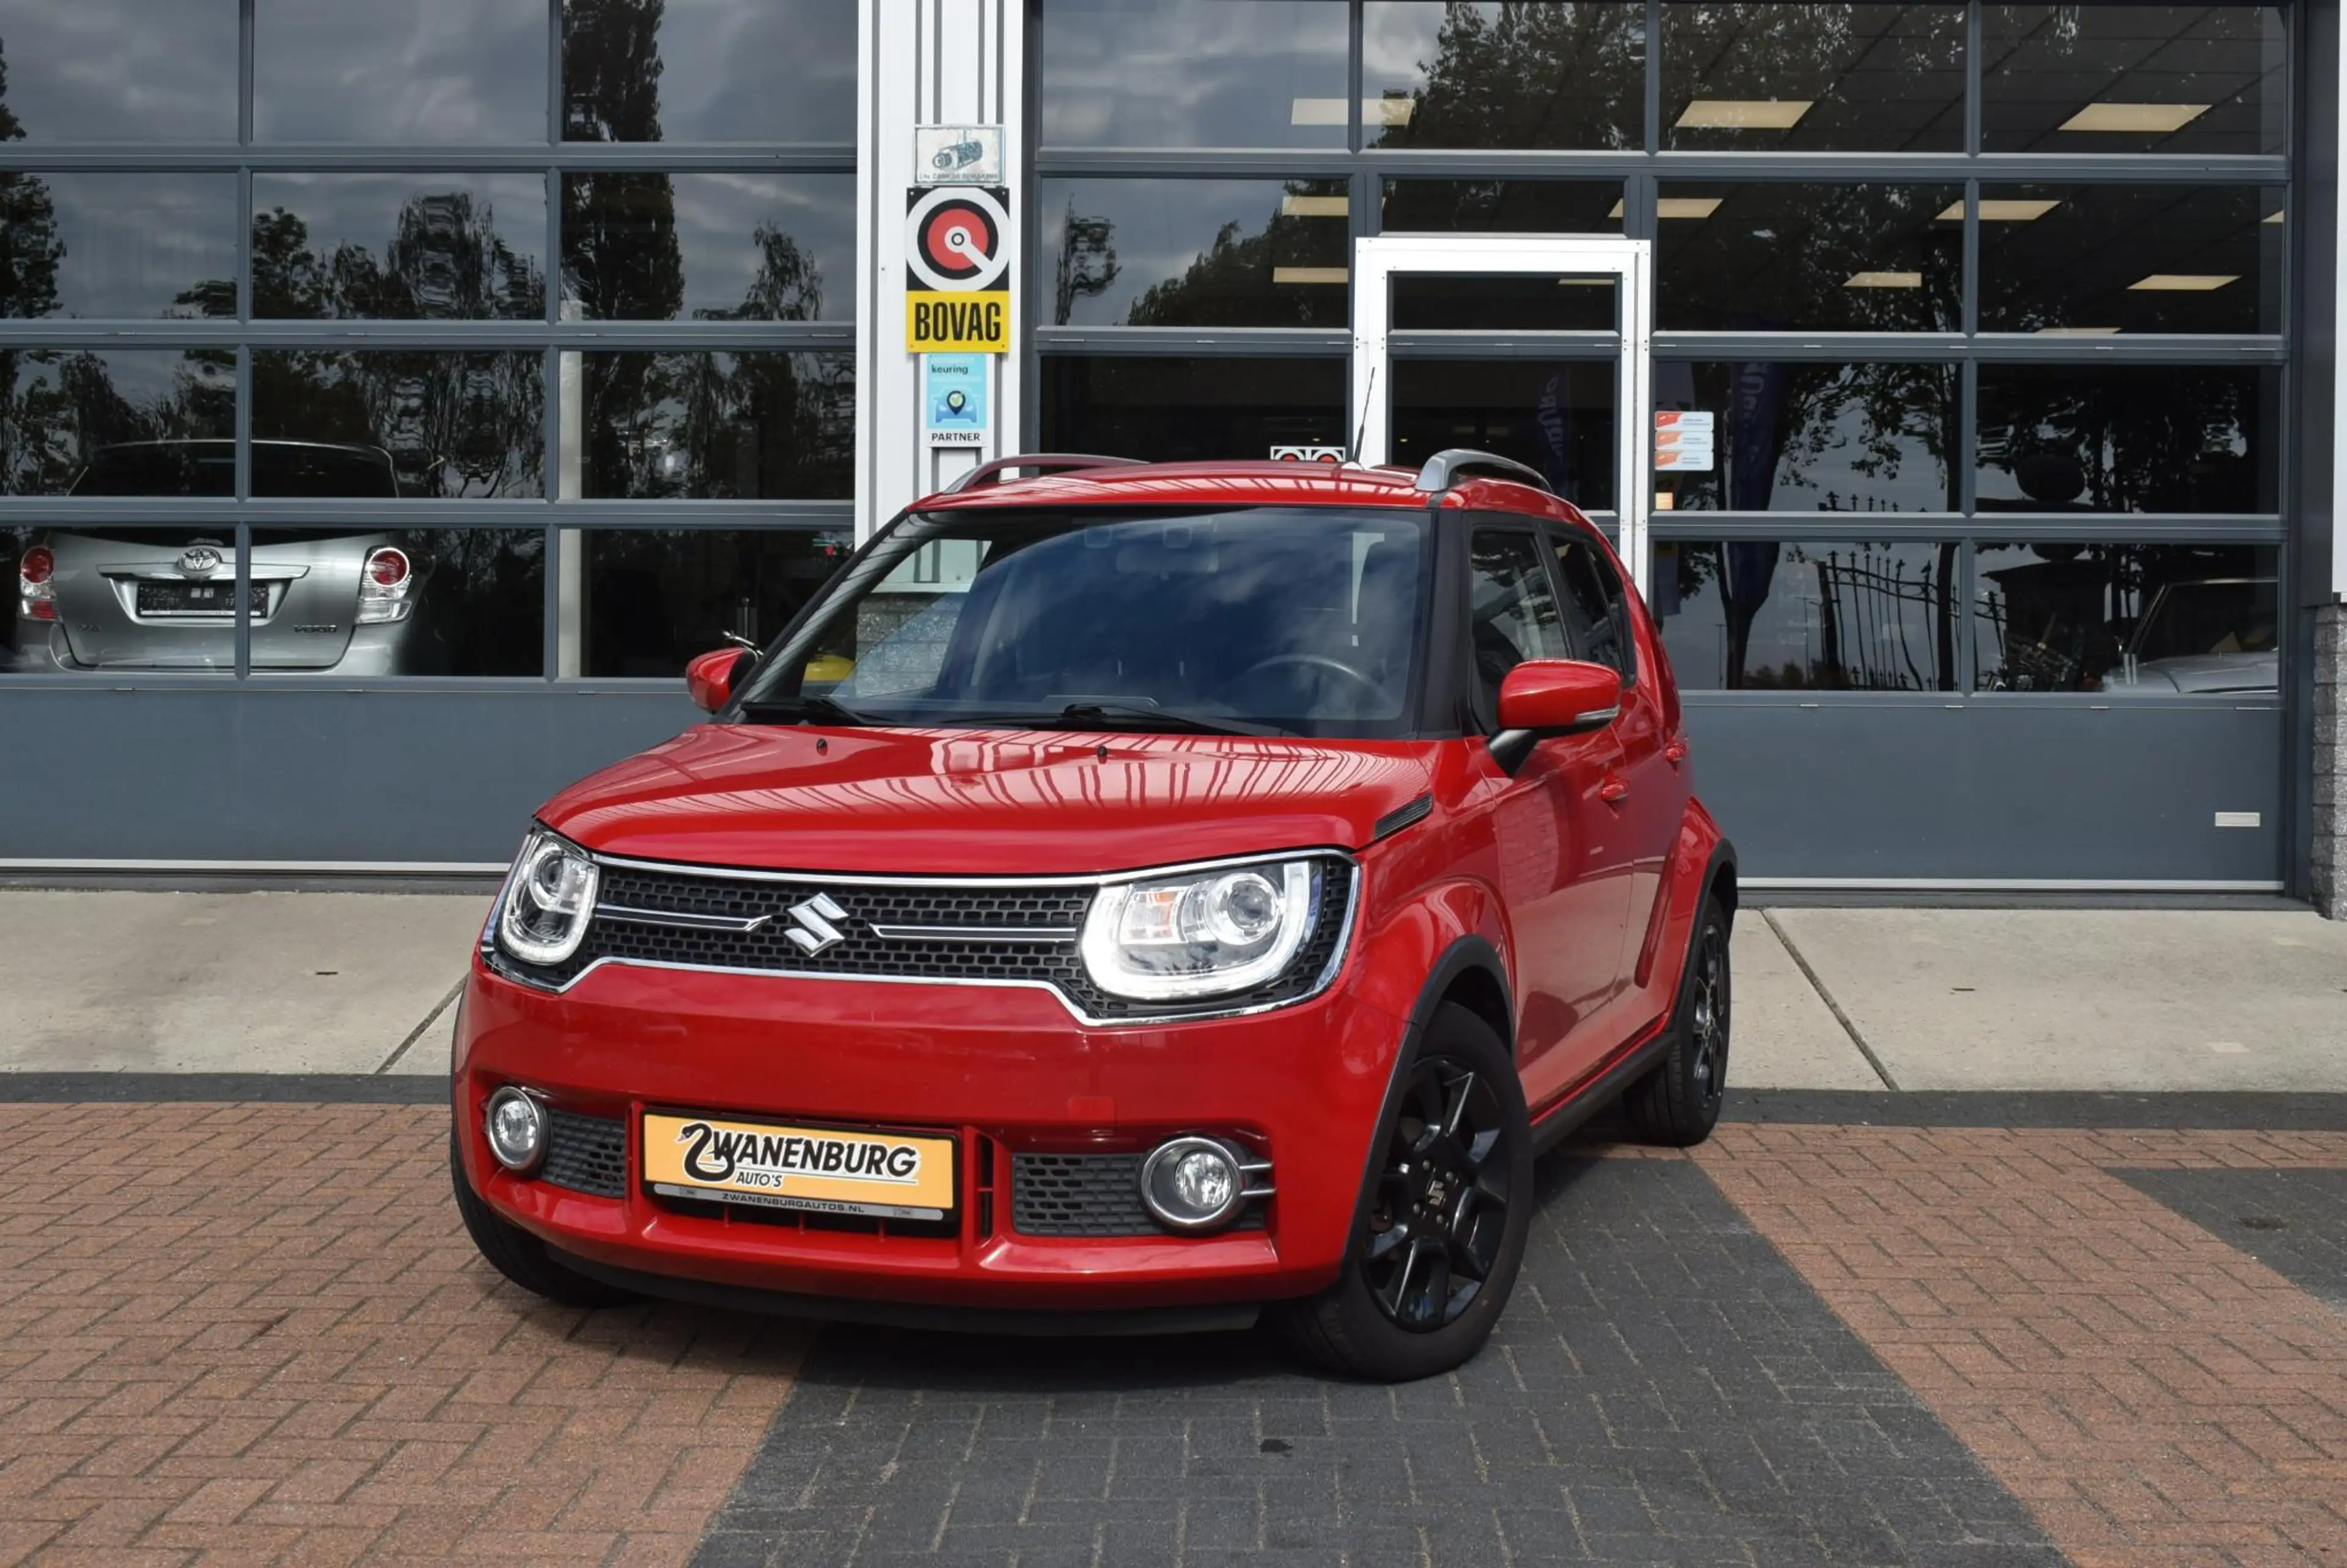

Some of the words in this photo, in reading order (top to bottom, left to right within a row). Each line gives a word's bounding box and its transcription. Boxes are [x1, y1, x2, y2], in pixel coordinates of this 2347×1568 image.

[915, 302, 1001, 342] BOVAG
[931, 364, 968, 375] keuring
[931, 433, 980, 441] PARTNER
[736, 1171, 782, 1187] AUTO'S
[722, 1192, 865, 1213] ZWANENBURGAUTOS.NL
